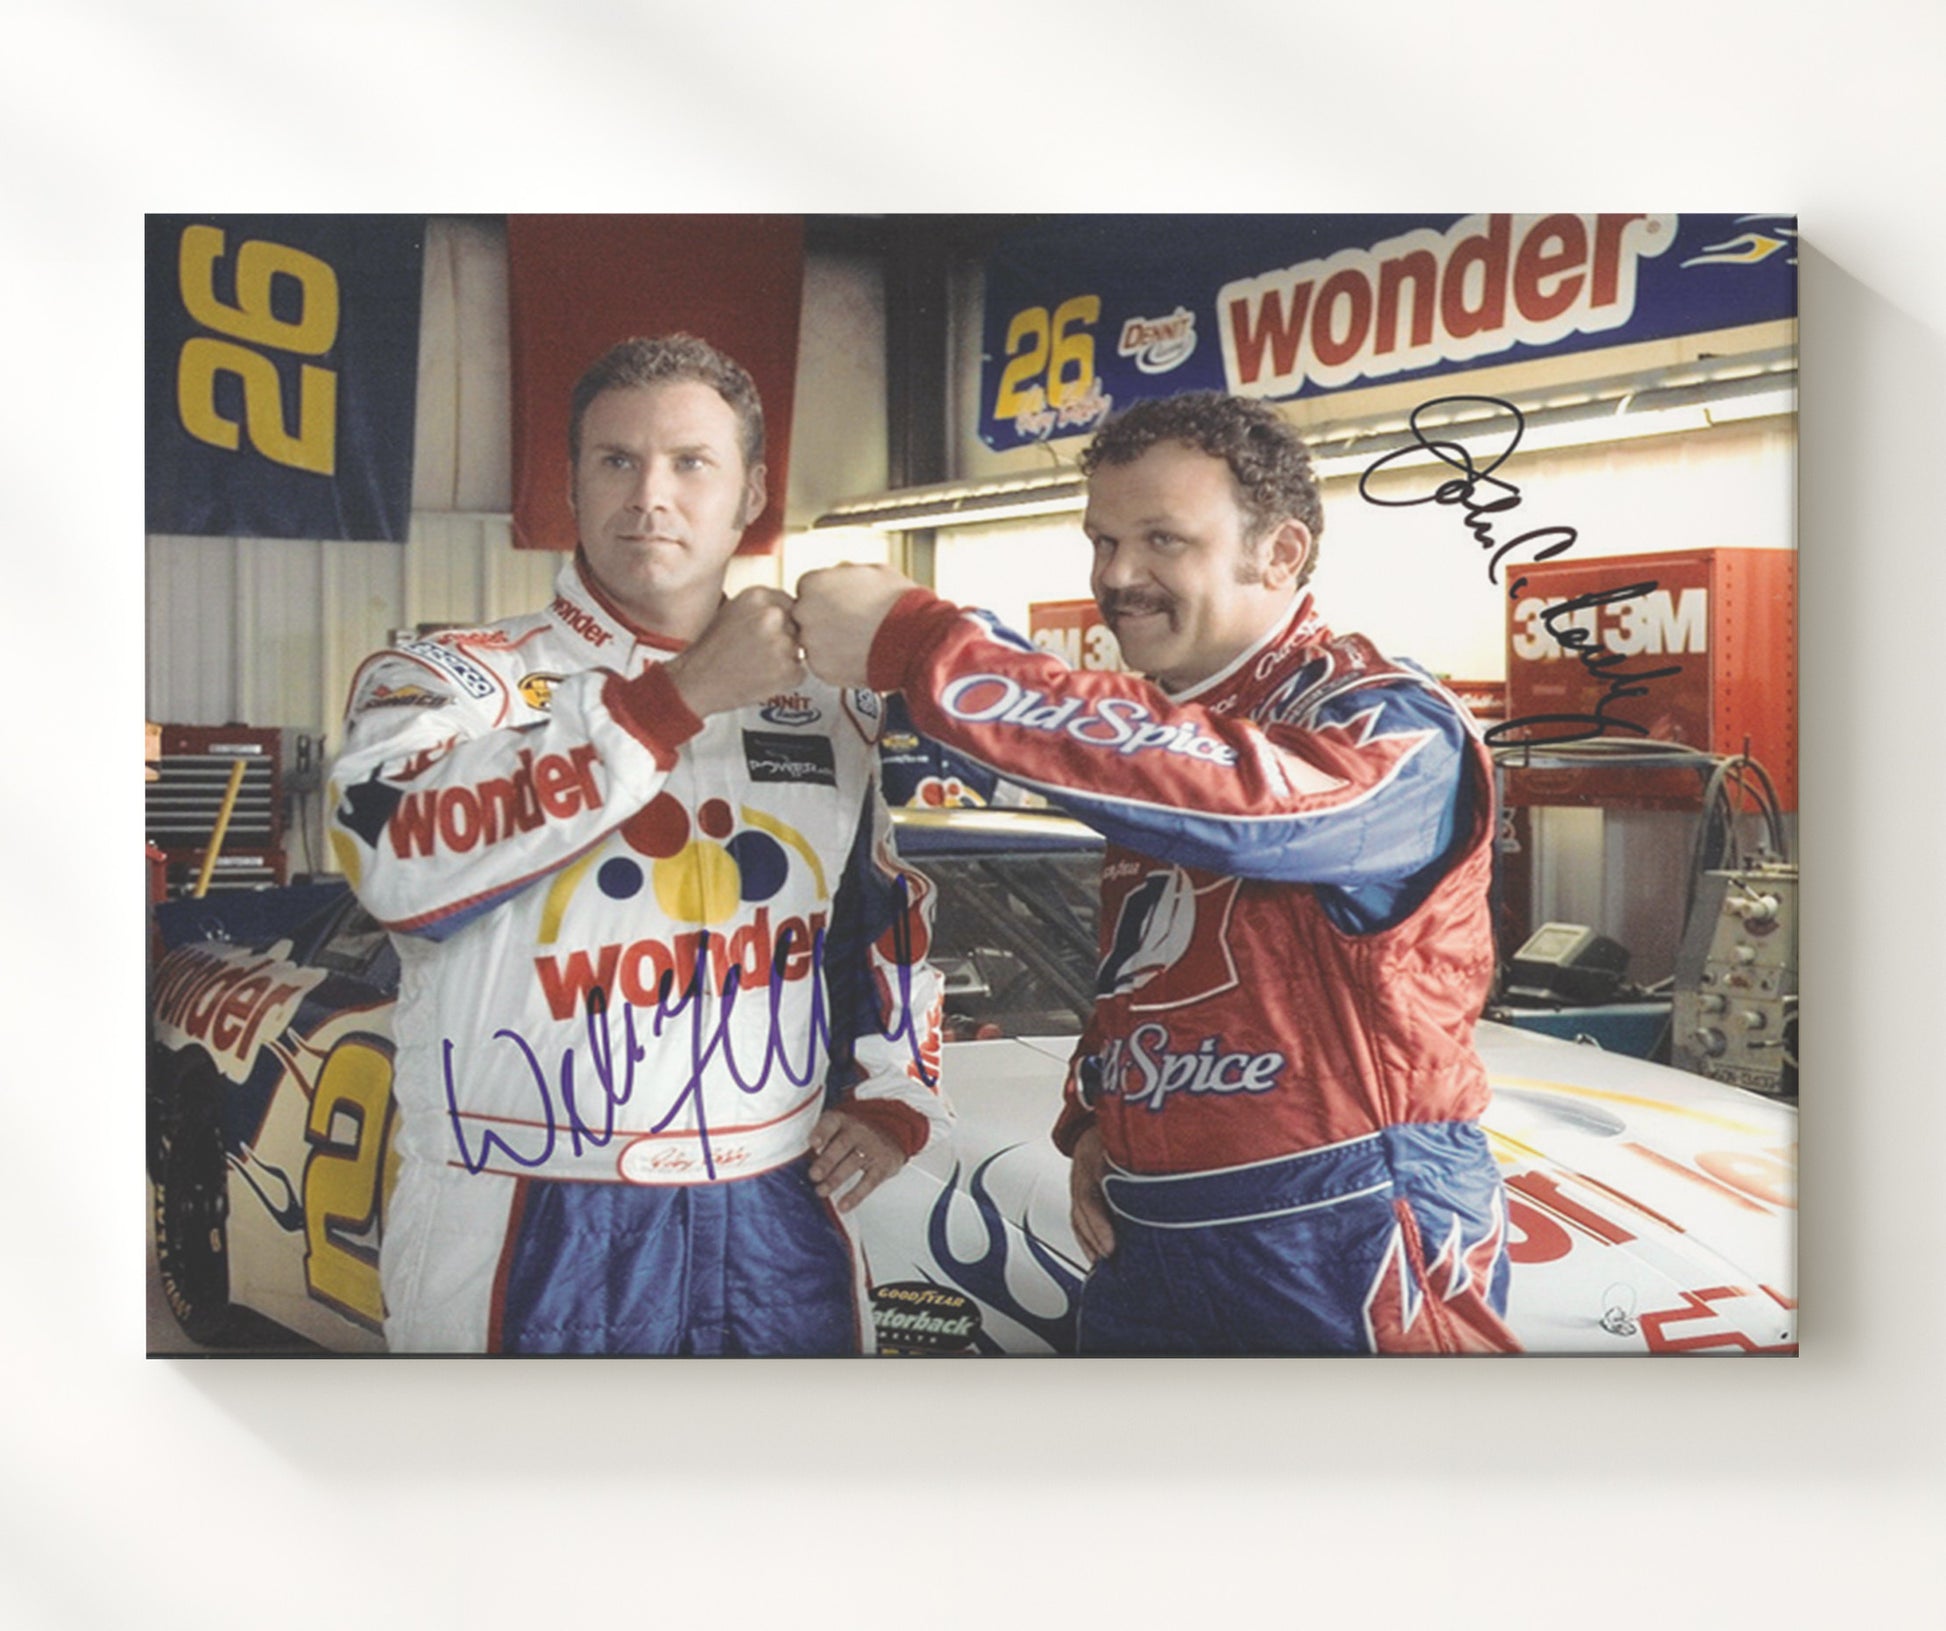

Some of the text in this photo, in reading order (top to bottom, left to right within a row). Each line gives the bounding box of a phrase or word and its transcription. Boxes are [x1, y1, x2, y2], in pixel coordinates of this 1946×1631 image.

[178, 224, 339, 476] 26
[994, 294, 1101, 420] 26
[1230, 213, 1647, 385] wonder
[1512, 587, 1707, 661] 3M 3M
[941, 674, 1239, 767] Old Spice
[387, 743, 604, 859] wonder
[1122, 1022, 1284, 1110] Spice
[304, 1034, 401, 1334] 2
[870, 1305, 974, 1336] atorback
